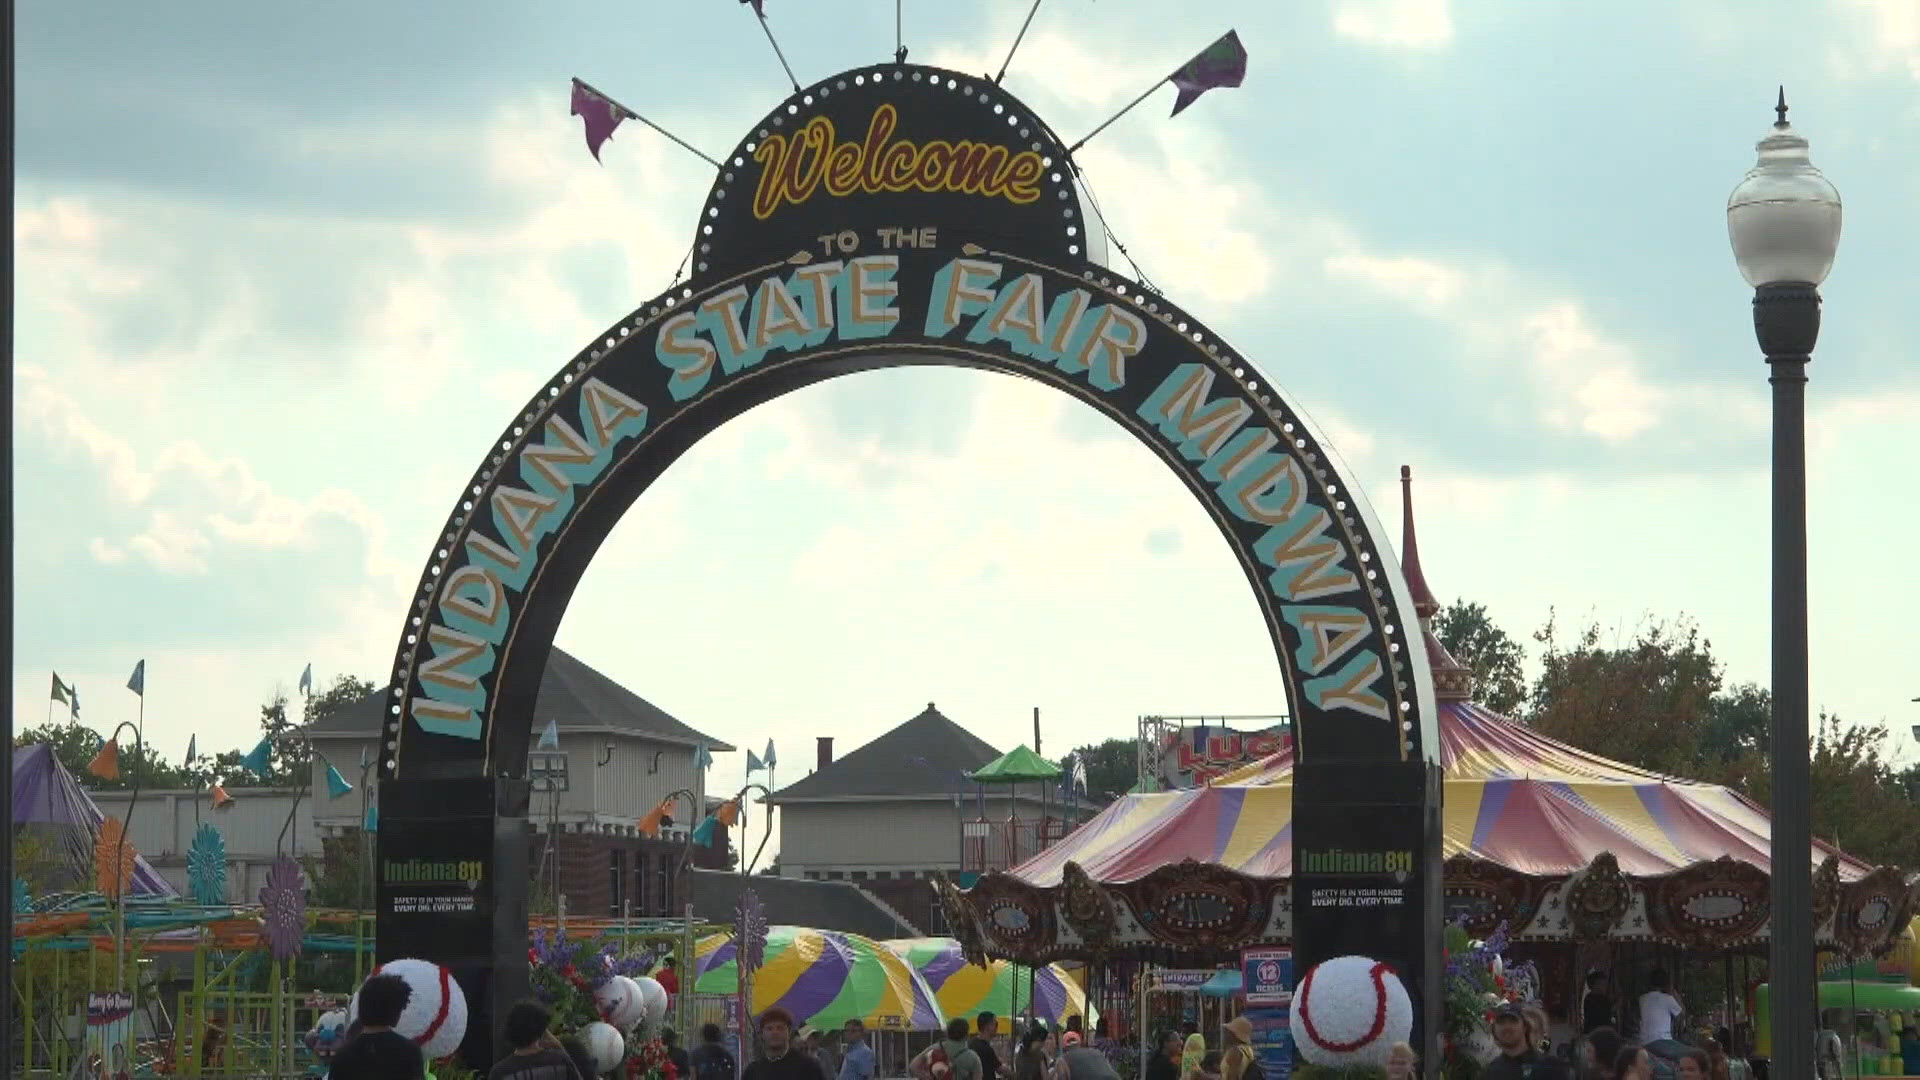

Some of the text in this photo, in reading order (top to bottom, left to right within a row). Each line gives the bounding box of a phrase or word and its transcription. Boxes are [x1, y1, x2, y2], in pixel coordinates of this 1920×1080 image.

[753, 104, 1044, 220] Welcome
[818, 227, 937, 257] TO THE
[411, 255, 1391, 740] INDIANA STATE FAIR MIDWAY
[1178, 733, 1293, 770] LUC
[1312, 898, 1337, 906] EVERY
[1163, 974, 1203, 983] ENTRANCE
[1260, 965, 1277, 981] 12
